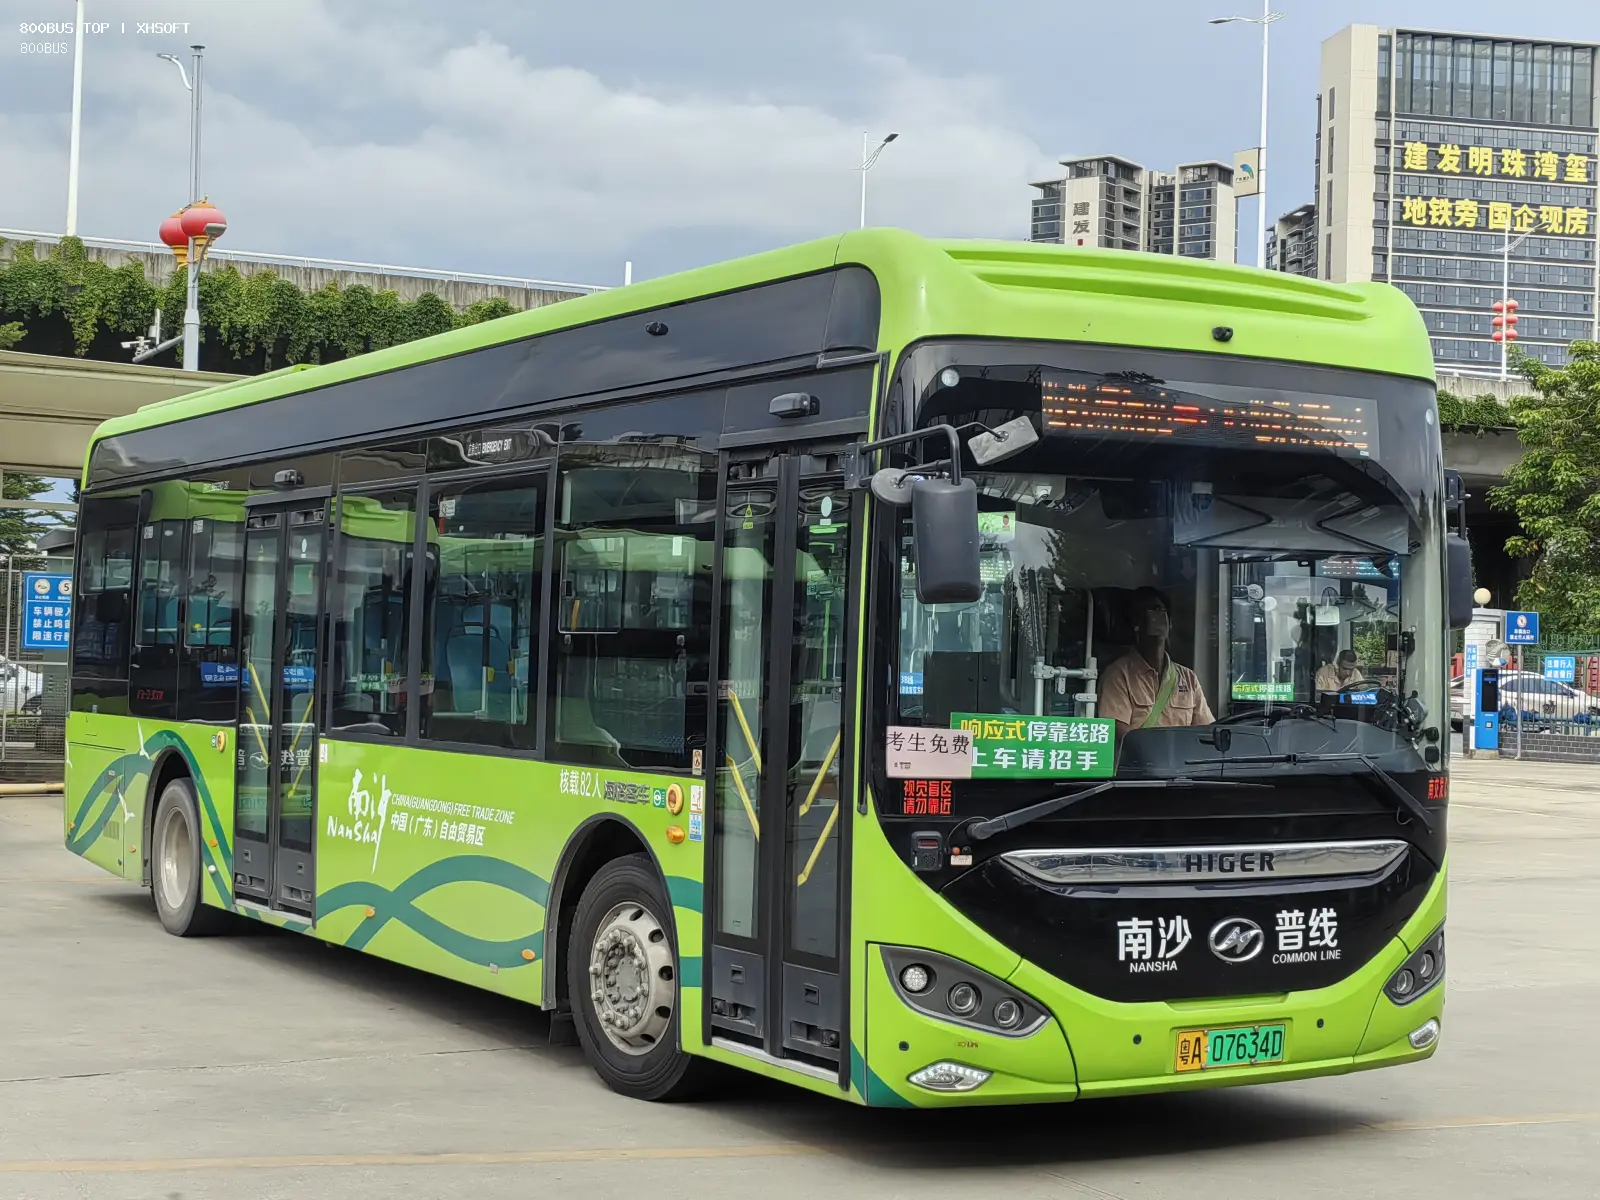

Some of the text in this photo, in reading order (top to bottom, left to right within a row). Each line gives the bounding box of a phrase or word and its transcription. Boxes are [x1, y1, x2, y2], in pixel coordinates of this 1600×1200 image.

[1403, 141, 1588, 183] 建发明珠湾玺
[1072, 201, 1090, 235] 建发
[1402, 196, 1588, 235] 地铁旁 国企现房
[63, 582, 70, 592] 5
[886, 731, 970, 755] 考生免费
[961, 719, 1109, 743] 响应式停靠线路
[971, 747, 1099, 771] 上车请招手
[903, 780, 952, 797] 视觉盲区
[471, 805, 495, 822] TRADE
[494, 810, 516, 825] ZONE
[903, 797, 952, 815] 请勿靠近
[1186, 852, 1276, 873] HIGER
[1116, 915, 1192, 961] 南沙
[1275, 907, 1338, 951] 普线
[1129, 960, 1178, 973] NANSHA
[1272, 949, 1341, 965] COMMON LINE
